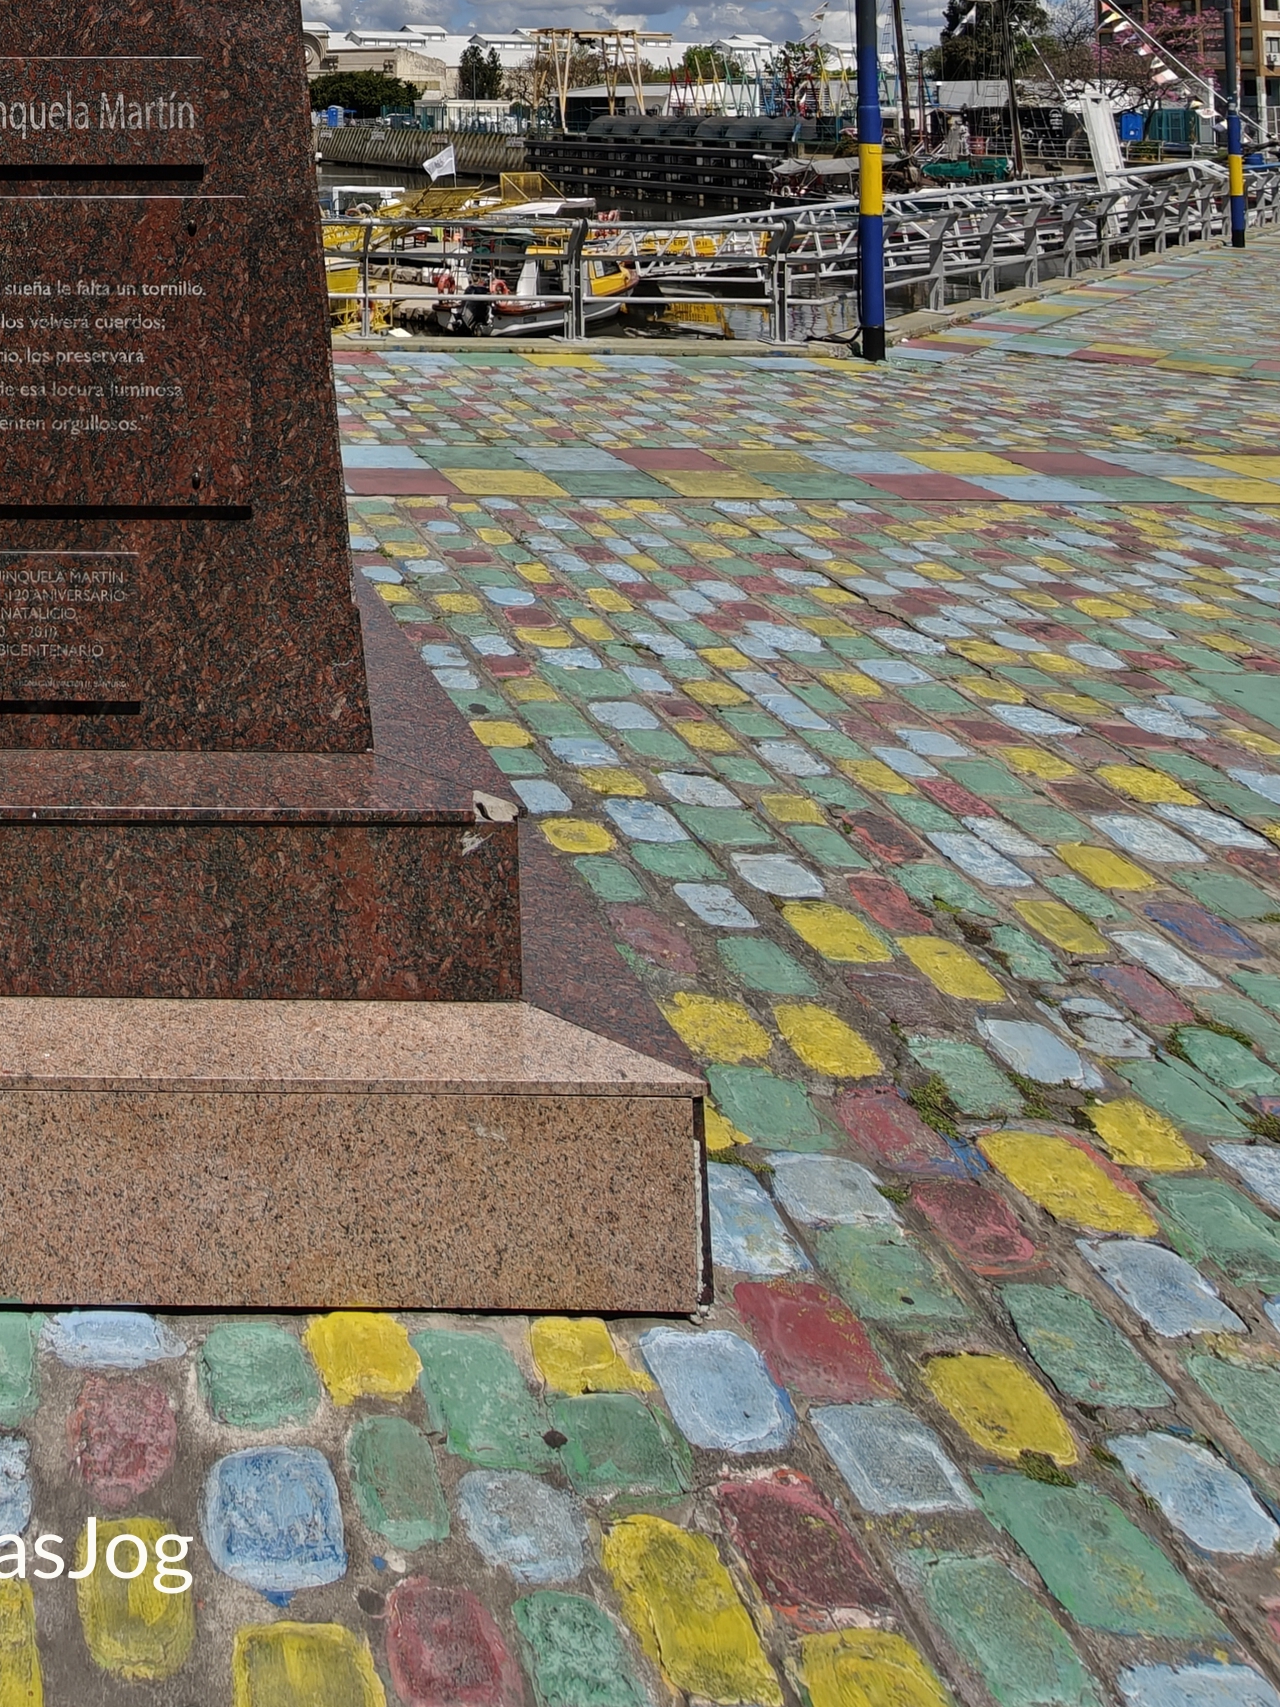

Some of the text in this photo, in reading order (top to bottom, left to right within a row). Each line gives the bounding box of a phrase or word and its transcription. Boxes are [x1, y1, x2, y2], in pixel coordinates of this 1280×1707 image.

[99, 91, 195, 130] Martín
[5, 280, 51, 295] sueña
[57, 280, 70, 295] le
[76, 280, 110, 295] falta
[117, 284, 136, 295] un
[142, 280, 206, 295] tornillo.
[1, 313, 24, 328] los
[30, 314, 89, 329] volverá
[94, 314, 166, 331] cuerdos;
[27, 347, 50, 363] los
[56, 349, 145, 366] preservará
[20, 385, 46, 396] esa
[52, 381, 104, 397] locura
[111, 381, 183, 397] luminosa
[33, 588, 125, 602] ANIVERSARIO
[1, 607, 77, 620] NATALICIO
